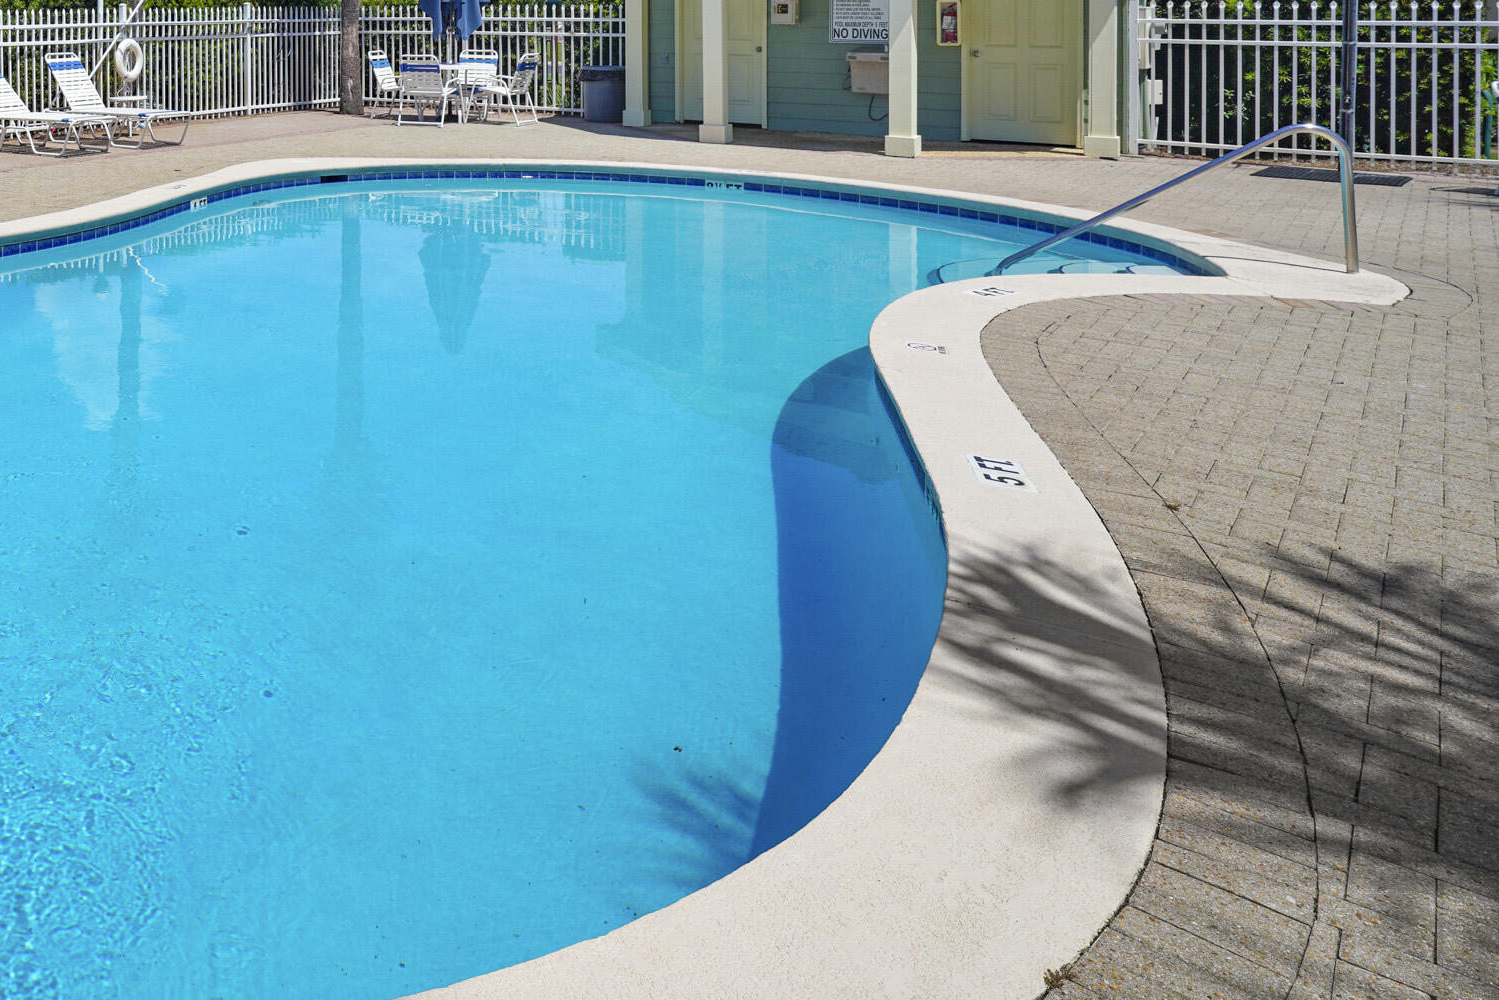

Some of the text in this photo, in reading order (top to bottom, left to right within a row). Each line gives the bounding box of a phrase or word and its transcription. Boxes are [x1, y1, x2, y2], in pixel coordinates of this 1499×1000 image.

[833, 28, 889, 39] NO DIVING
[983, 473, 1025, 486] 5
